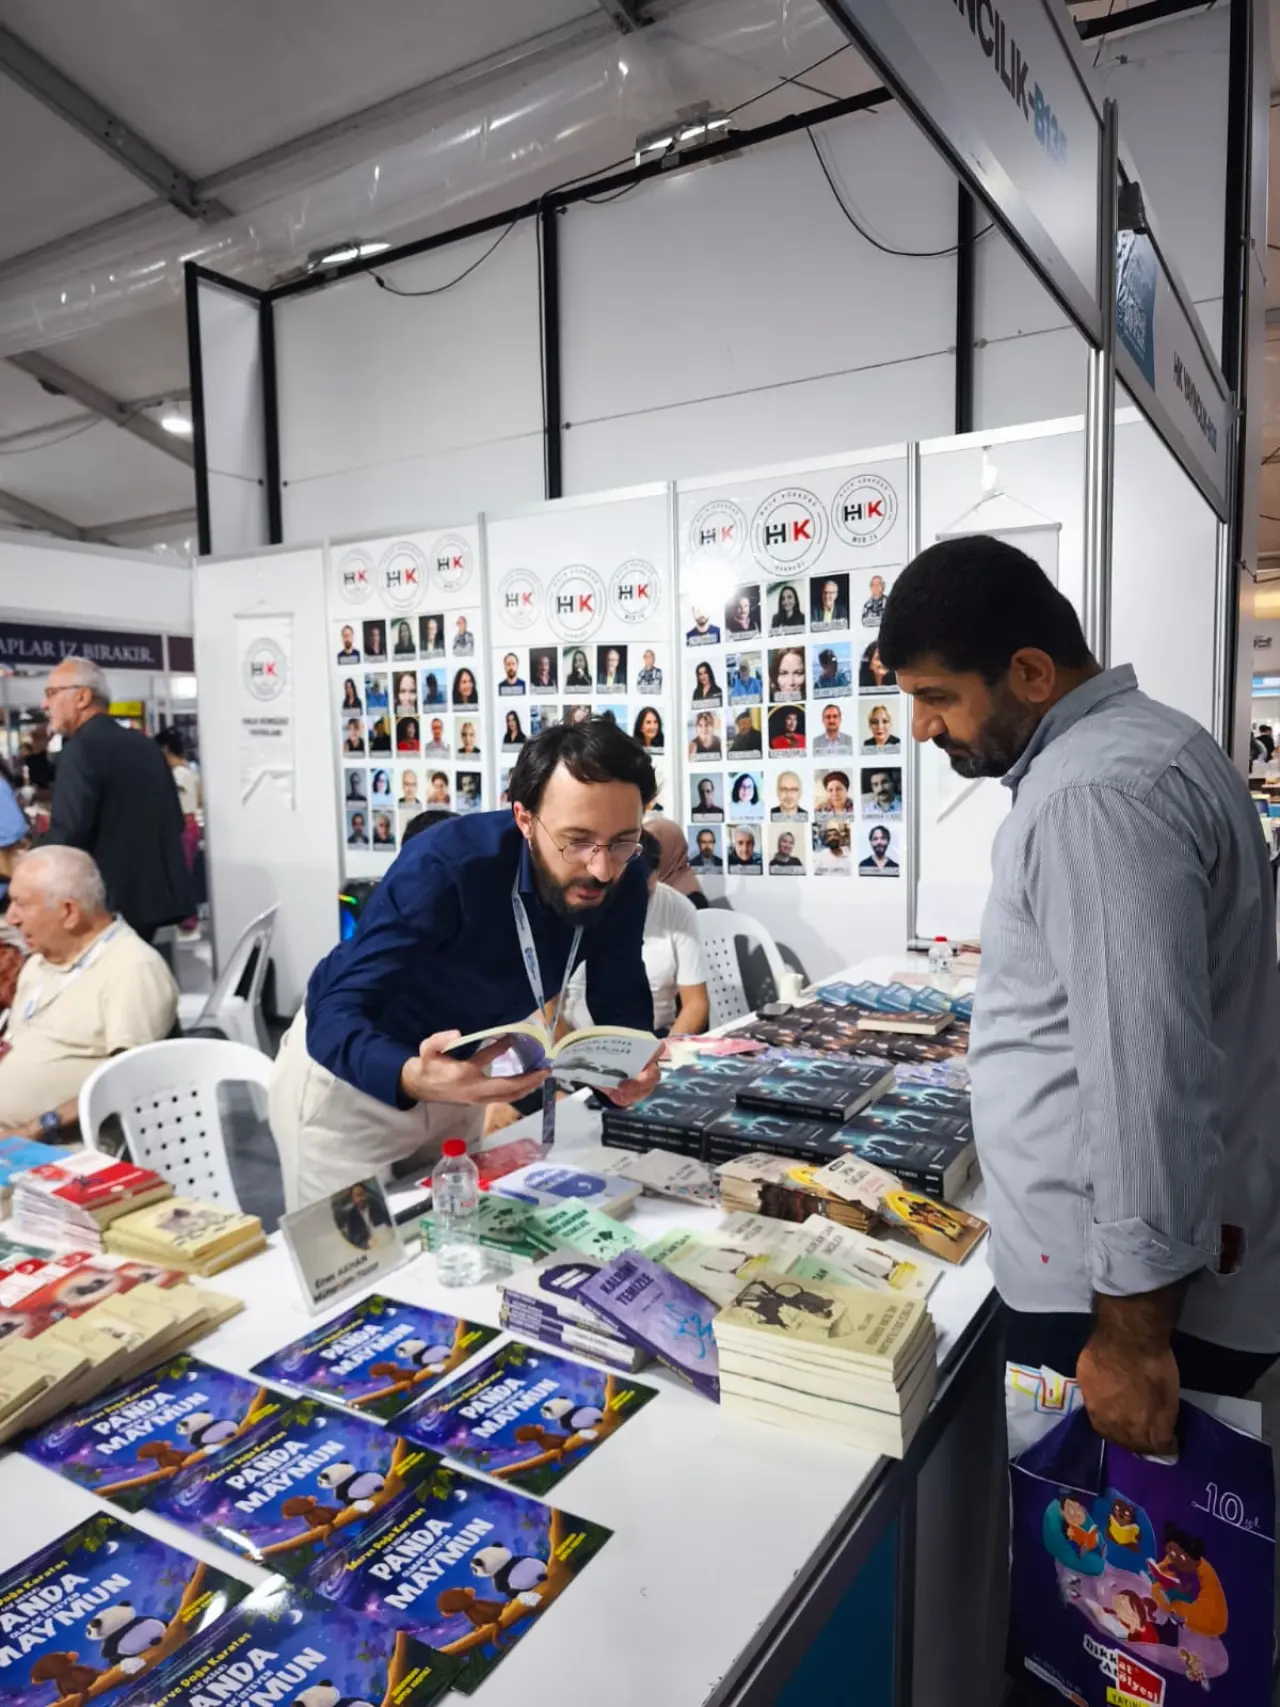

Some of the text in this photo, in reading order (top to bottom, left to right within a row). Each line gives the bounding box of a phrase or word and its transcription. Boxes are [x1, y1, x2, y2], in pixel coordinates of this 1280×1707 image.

[319, 1324, 384, 1360] PANDA
[330, 1323, 415, 1375] MAYMUN
[93, 1391, 176, 1435] PANDA
[95, 1392, 210, 1455] MAYMUN
[458, 1378, 527, 1419] PANDA
[471, 1378, 561, 1439] MAYMUN
[226, 1440, 309, 1490] PANDA
[234, 1440, 346, 1513] MAYMUN
[368, 1519, 453, 1581] PANDA
[384, 1517, 495, 1610] MAYMUN
[180, 1665, 211, 1688] Doğa
